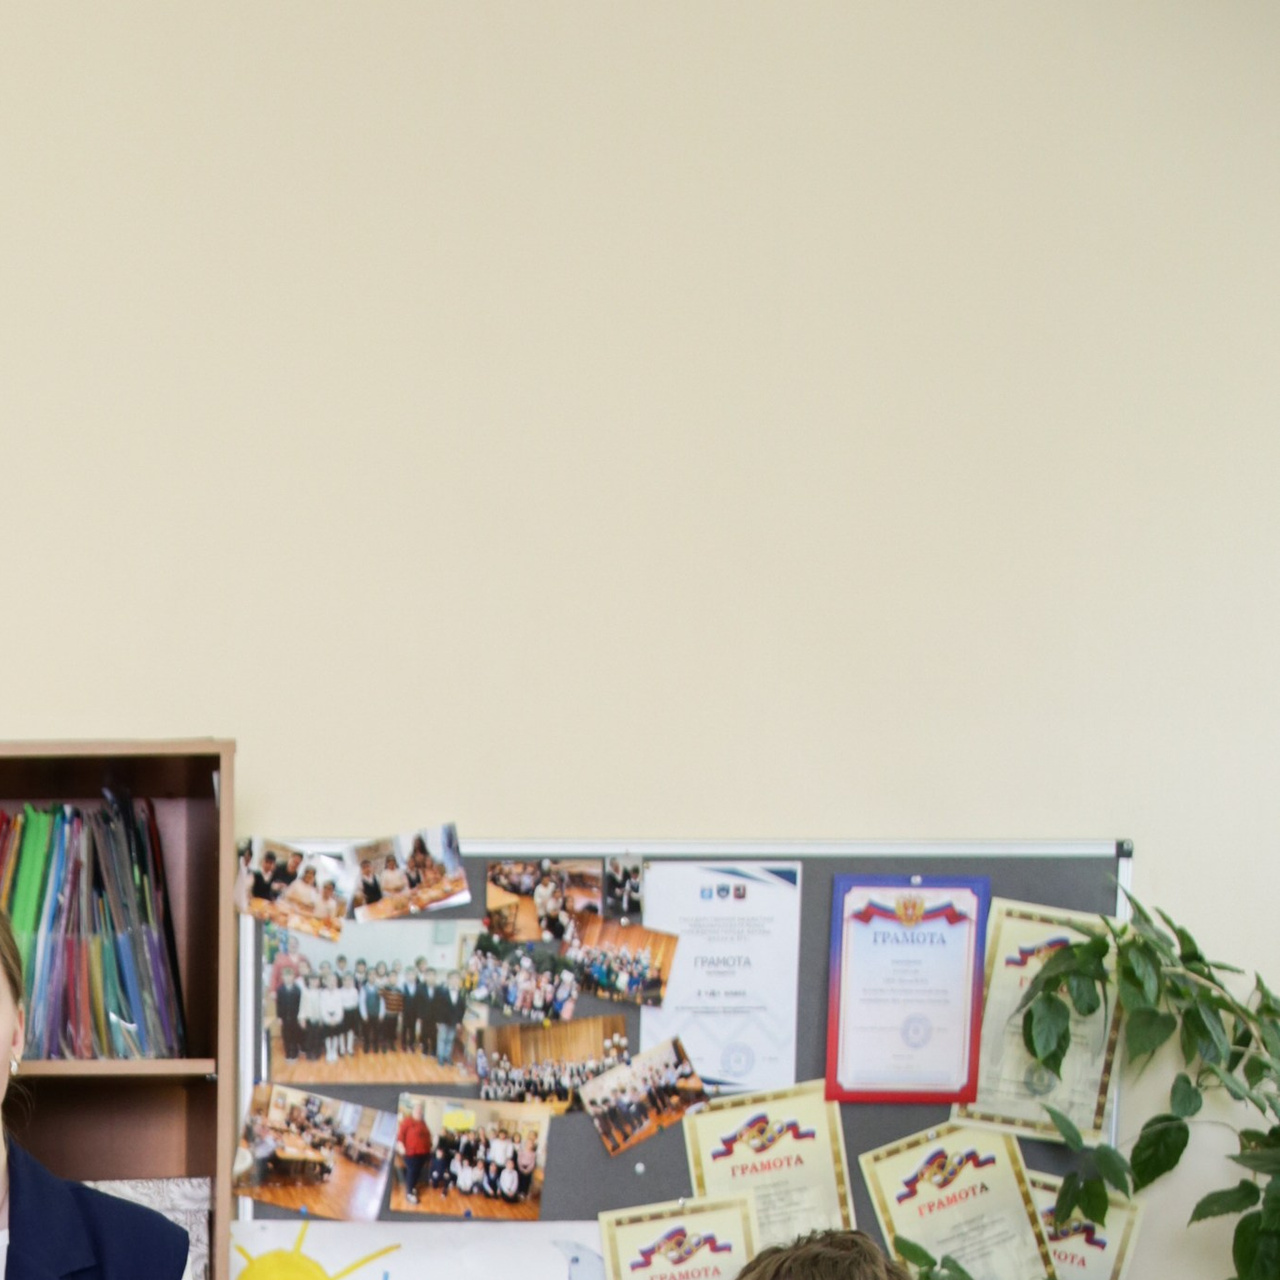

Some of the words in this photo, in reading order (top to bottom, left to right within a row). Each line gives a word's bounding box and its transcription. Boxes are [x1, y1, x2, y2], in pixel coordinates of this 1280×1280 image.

[872, 931, 947, 946] ГРАМОТА
[693, 955, 752, 969] ГРАМОТА
[730, 1154, 804, 1178] ГРАМОТА
[918, 1181, 990, 1218] ГРАМОТА
